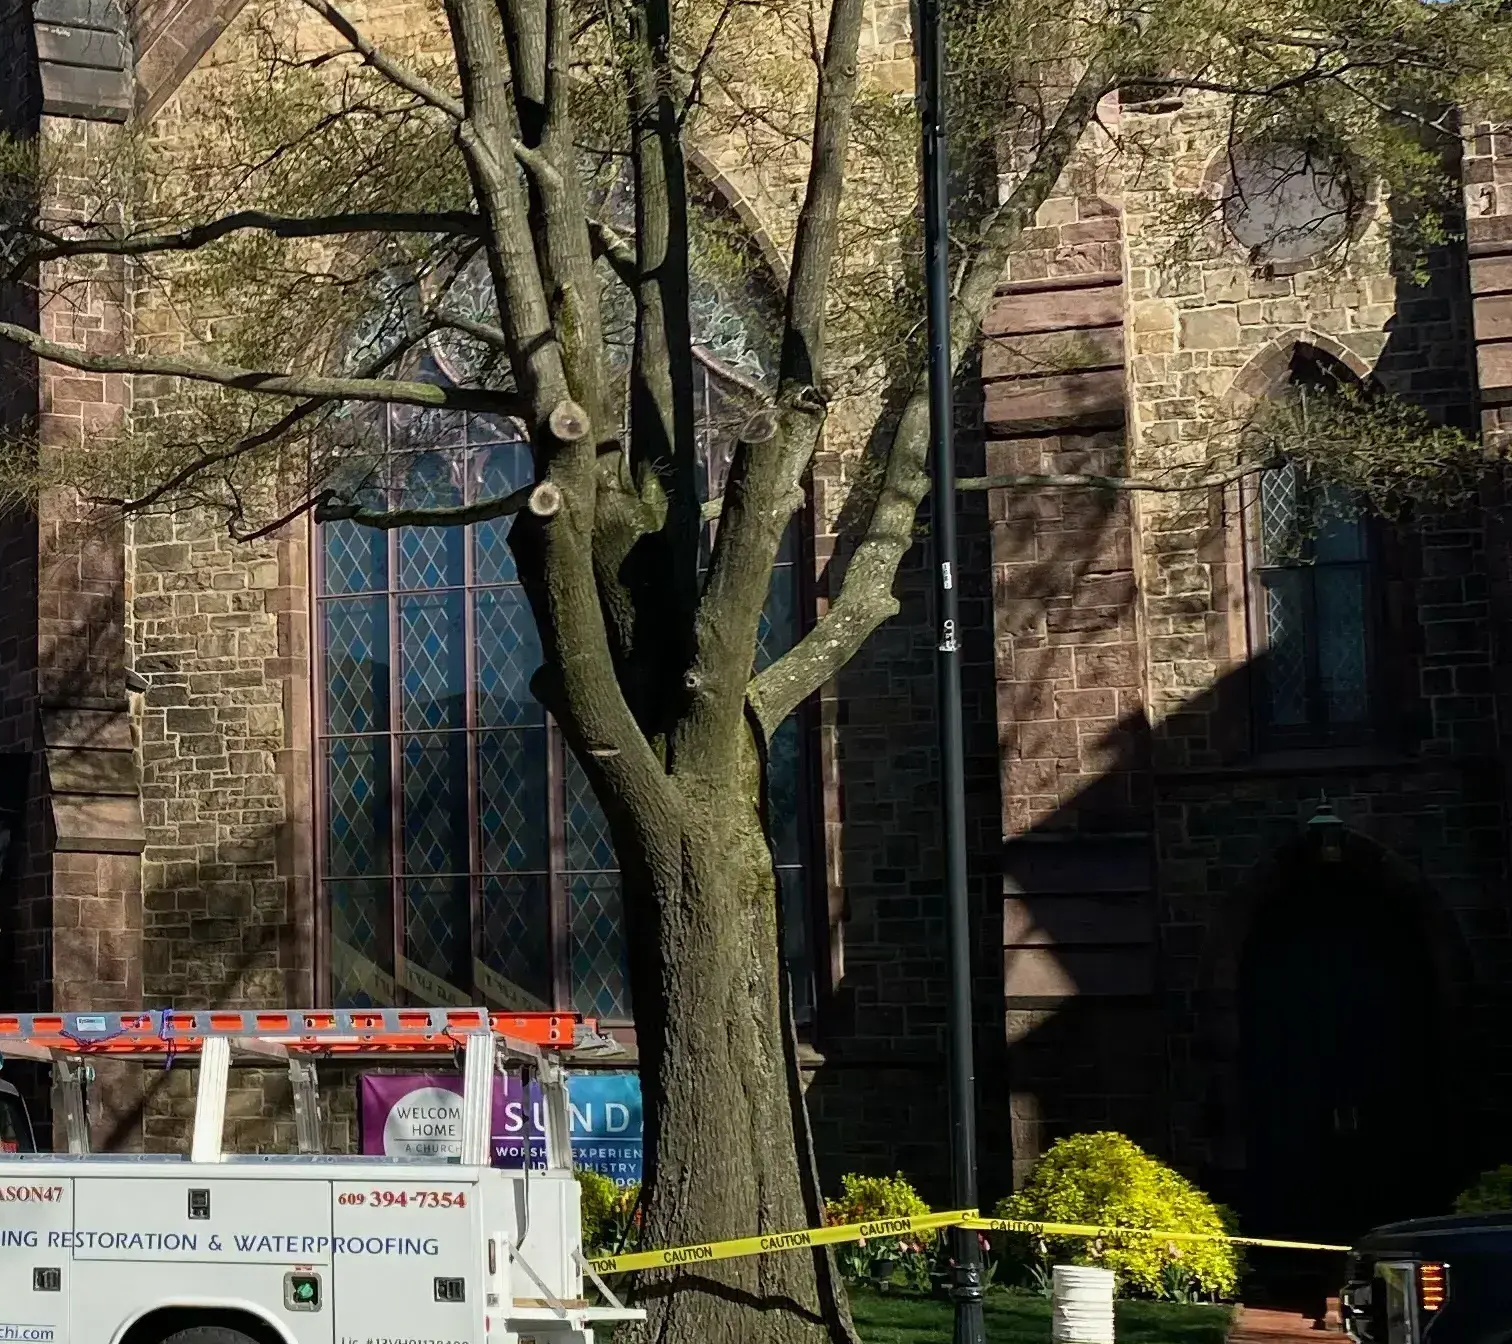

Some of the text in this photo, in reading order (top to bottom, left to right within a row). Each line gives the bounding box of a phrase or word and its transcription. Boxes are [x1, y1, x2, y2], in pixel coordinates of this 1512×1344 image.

[397, 1107, 461, 1121] WELCOM
[504, 1102, 643, 1133] SUND
[412, 1124, 456, 1137] HOME
[405, 1143, 462, 1154] A CHURCH
[572, 1147, 643, 1159] EXPERIEN
[338, 1191, 467, 1209] 609 394-7354
[989, 1219, 1044, 1233] CAUTION
[47, 1231, 197, 1251] RESTORATION
[208, 1234, 222, 1251] &
[234, 1235, 439, 1256] WATERPROOFING
[591, 1219, 912, 1273] TION CAUTION CAUTION CAUTION
